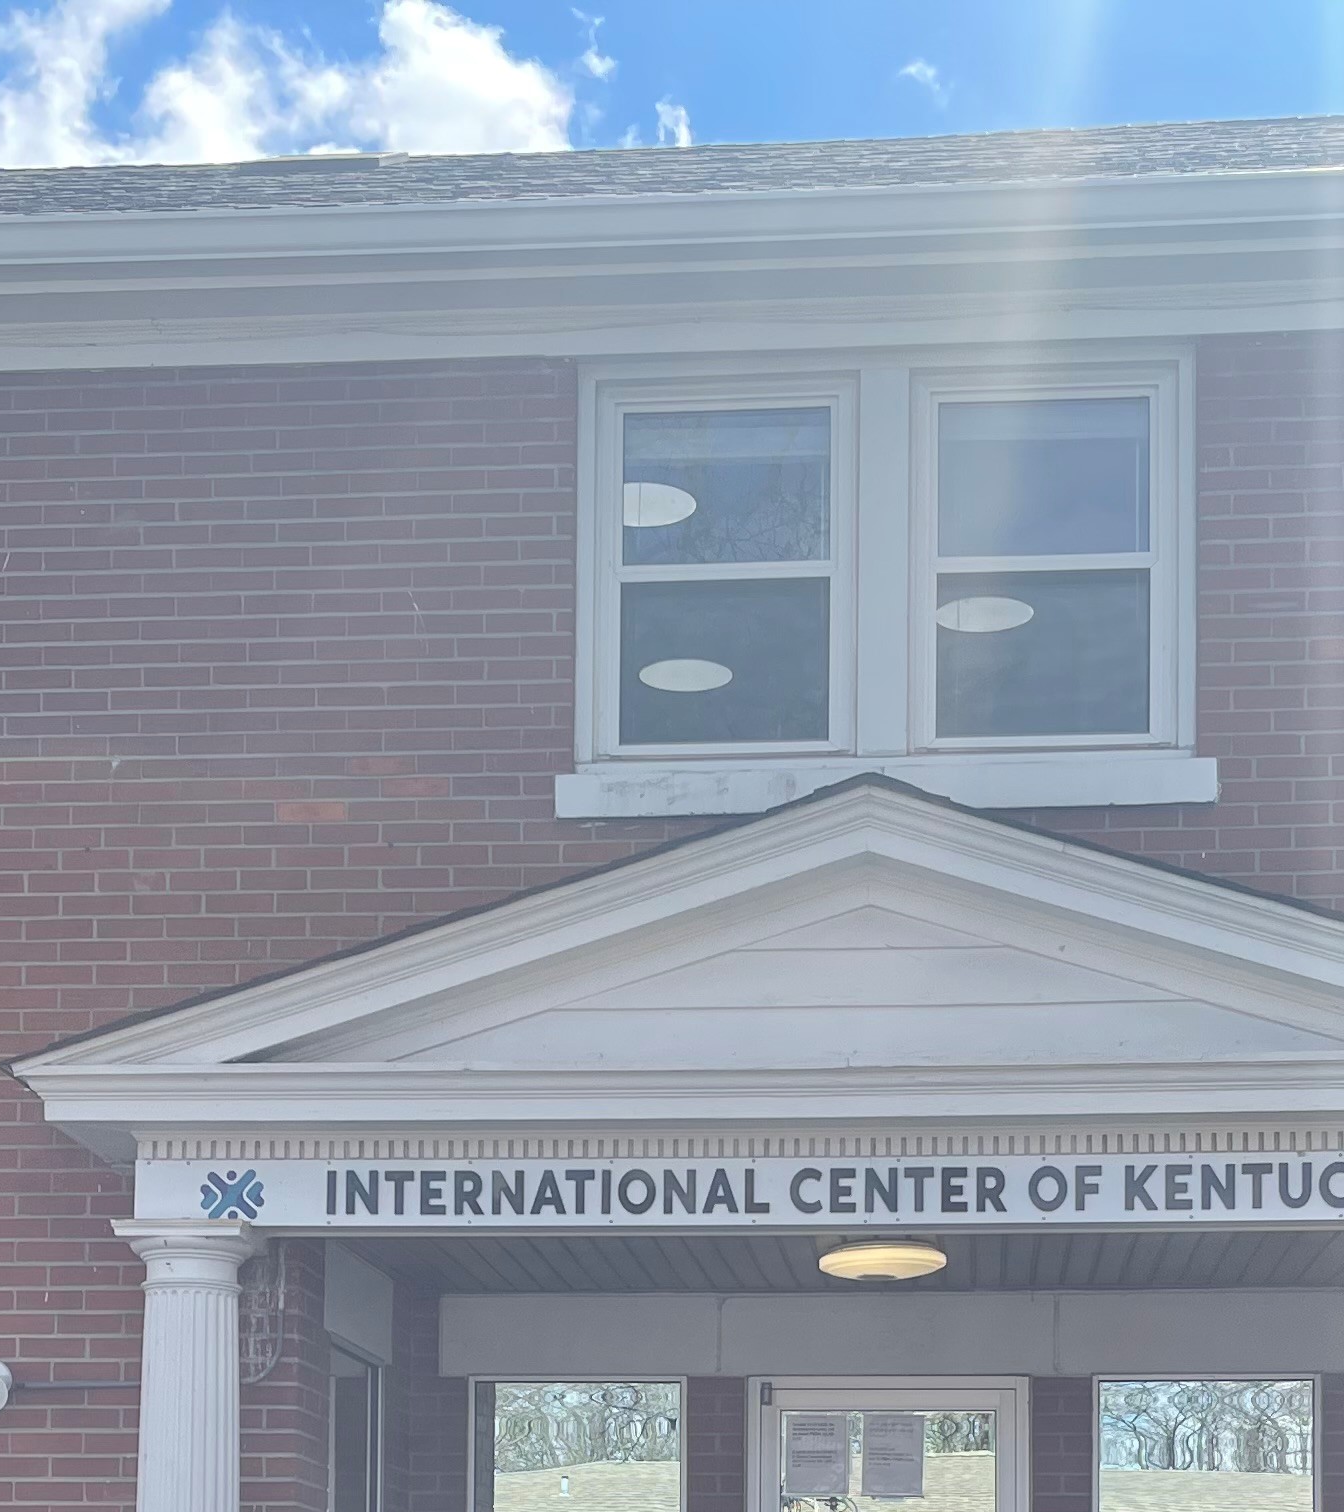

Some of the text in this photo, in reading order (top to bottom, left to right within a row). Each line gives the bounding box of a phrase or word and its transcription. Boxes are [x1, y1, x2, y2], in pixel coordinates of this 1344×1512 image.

[325, 1167, 771, 1216] INTERNATIONAL
[788, 1165, 1007, 1215] CENTER
[1027, 1165, 1103, 1213] OF
